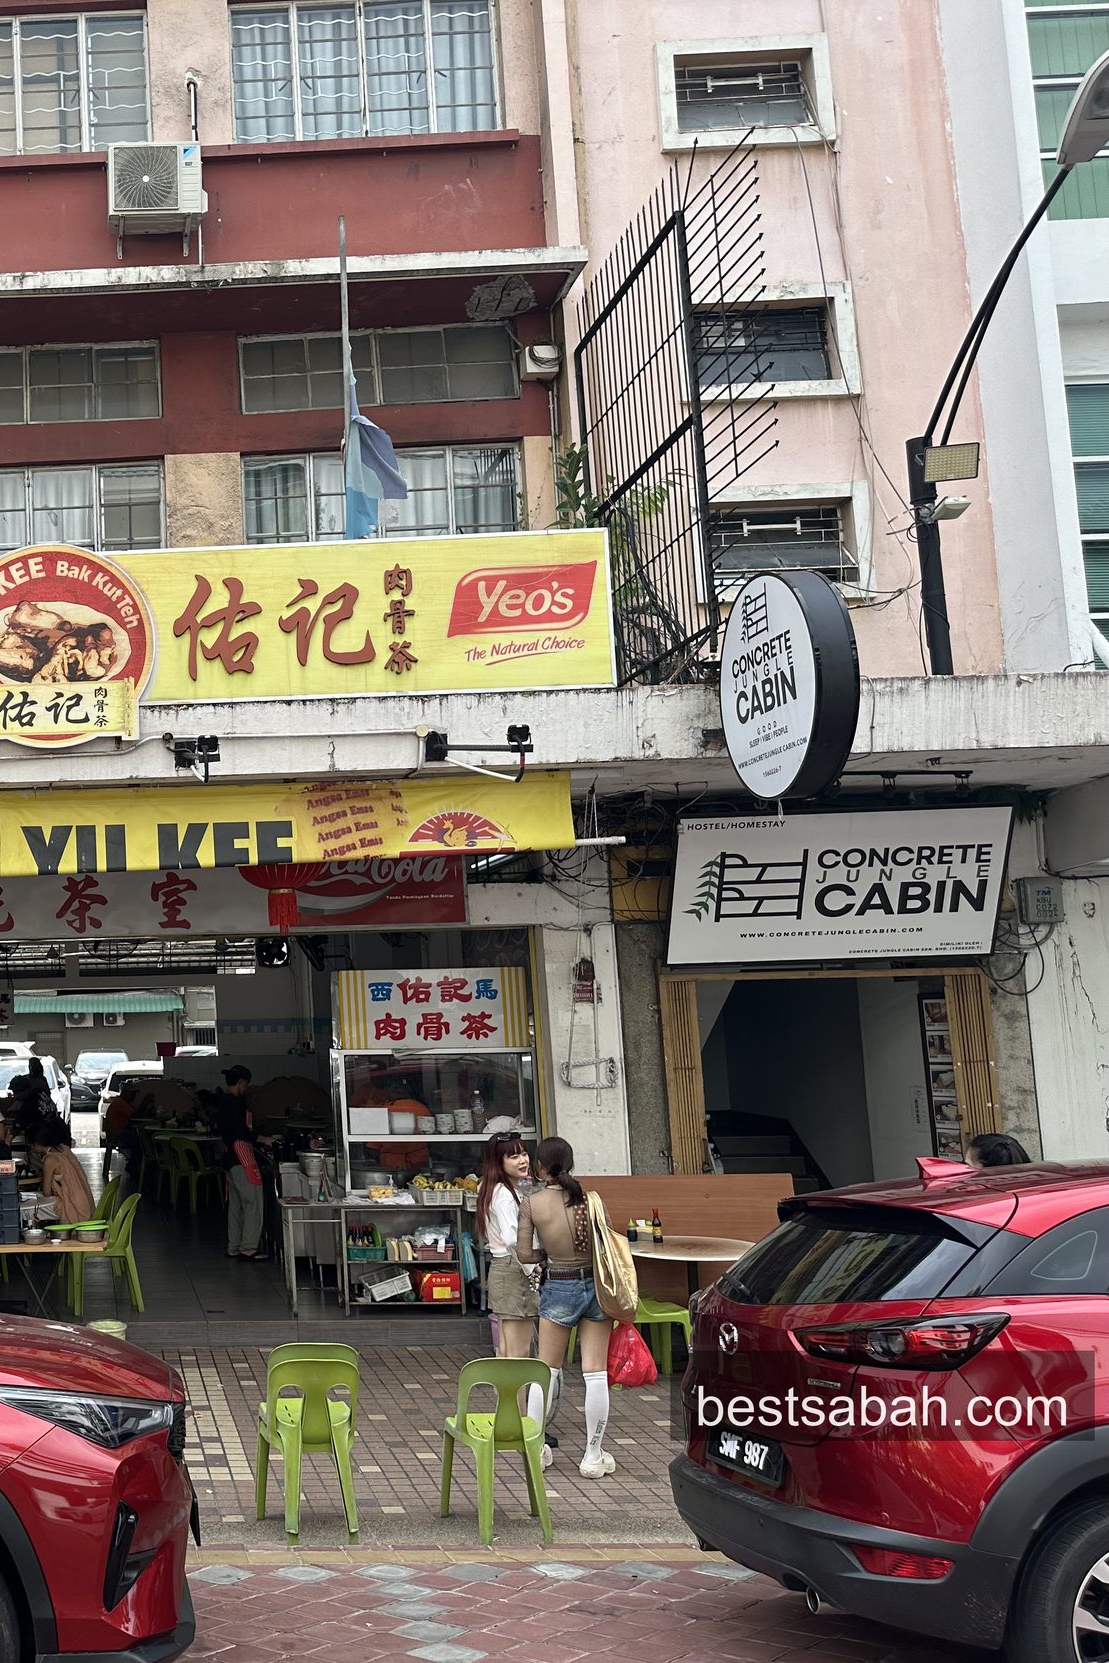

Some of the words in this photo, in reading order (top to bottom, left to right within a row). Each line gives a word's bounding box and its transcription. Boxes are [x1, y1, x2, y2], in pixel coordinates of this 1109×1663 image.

[56, 560, 92, 583] Bak
[92, 571, 124, 602] Kut
[116, 594, 139, 629] Teh
[477, 580, 575, 622] Yeo's
[384, 563, 418, 674] 肉骨茶
[464, 647, 486, 662] The
[490, 638, 539, 657] Natural
[542, 636, 585, 650] Choice
[732, 629, 792, 679] CONCRETE
[734, 650, 794, 694] JUNGLE
[93, 686, 109, 728] 肉骨茶
[736, 665, 797, 724] CABIN
[757, 720, 777, 735] GOOD
[312, 809, 348, 827] Angsa
[687, 820, 786, 831] HOSTEL/HOMESTAY
[157, 820, 292, 870] KEE
[317, 826, 352, 843] Angsa
[322, 842, 357, 860] Angsa
[817, 843, 993, 869] CONCRETE
[816, 864, 990, 884] JUNGLE
[814, 879, 988, 917] CABIN
[740, 927, 923, 939] WWW.CONCRETEJUNGLECABIN.COM
[373, 1011, 498, 1041] 肉骨茶
[743, 1440, 769, 1471] 987
